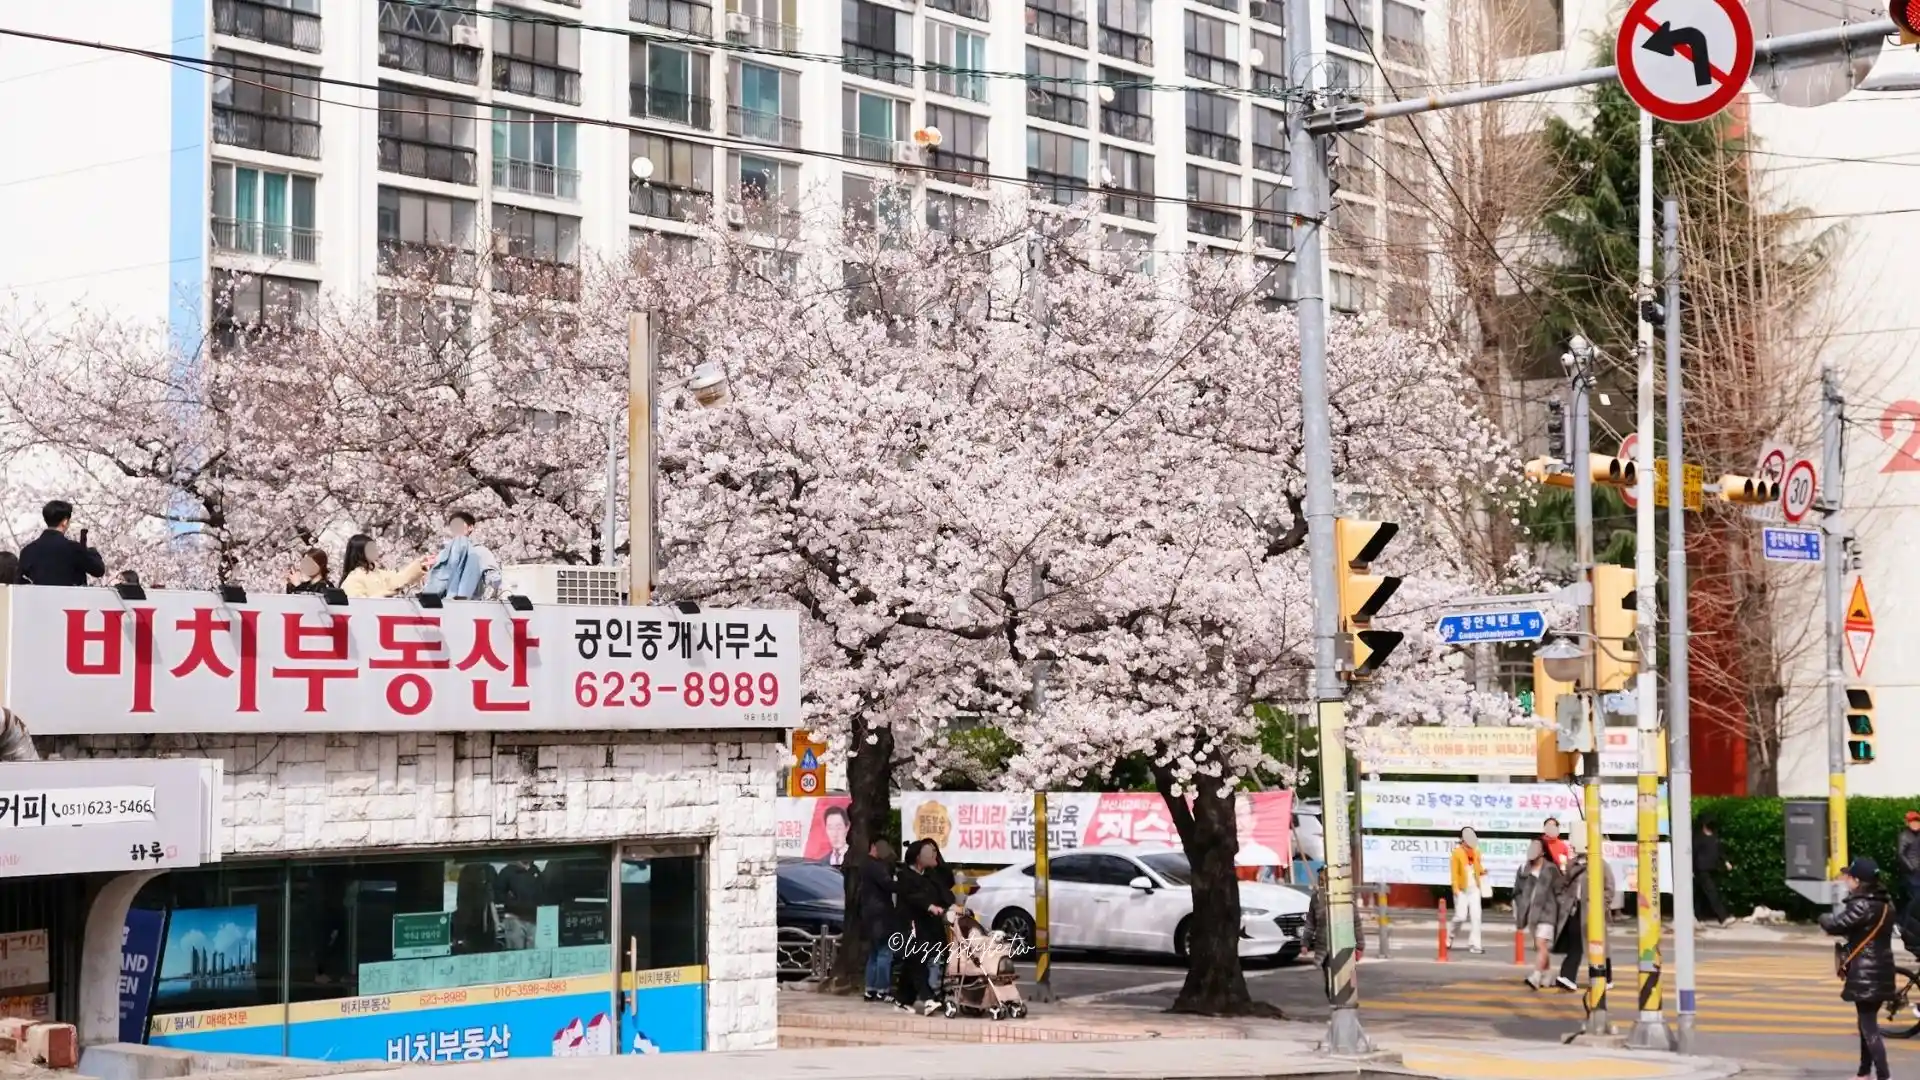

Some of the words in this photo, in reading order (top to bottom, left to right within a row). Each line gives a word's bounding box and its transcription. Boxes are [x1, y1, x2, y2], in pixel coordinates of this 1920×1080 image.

[1790, 477, 1809, 506] 30
[1461, 613, 1522, 631] 광안해변로
[1529, 618, 1541, 630] 91
[574, 617, 780, 662] 공인중개사무소
[62, 605, 540, 717] 비치부동산
[574, 670, 780, 708] 623-8989
[803, 777, 815, 787] 30
[0, 793, 47, 827] 커피
[1376, 793, 1411, 805] 2025년
[1415, 792, 1465, 809] 고등학교
[1470, 794, 1513, 809] 입학생
[958, 829, 1007, 851] 지키자
[1011, 828, 1078, 851] 대한민국
[130, 841, 165, 864] 하루
[638, 970, 682, 985] 비치부동산
[340, 998, 391, 1015] 비치부동산
[206, 1010, 248, 1028] 매매전문
[386, 1023, 512, 1063] 비치부동산
